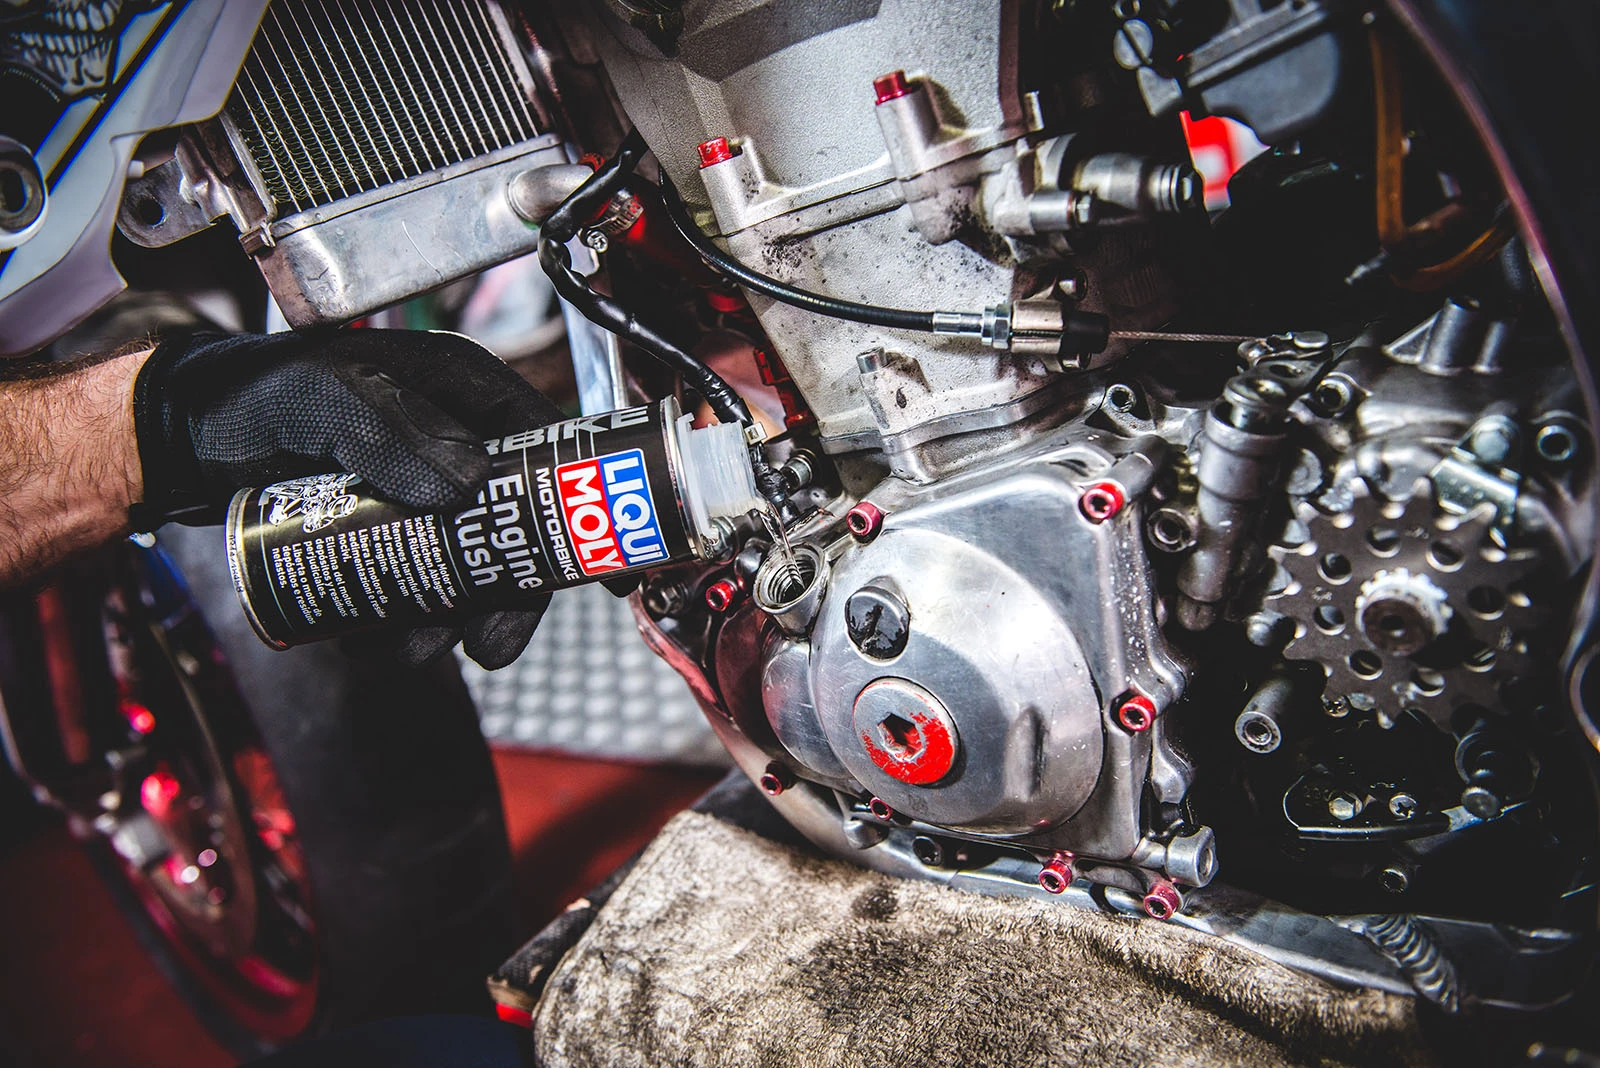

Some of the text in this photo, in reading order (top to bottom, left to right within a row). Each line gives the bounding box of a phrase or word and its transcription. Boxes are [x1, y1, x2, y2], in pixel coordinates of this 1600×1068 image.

[413, 516, 433, 568] schädlichen
[454, 490, 504, 586] lush
[488, 474, 543, 590] Engine
[535, 467, 580, 581] MOTORBIKE
[561, 465, 624, 569] MOLY
[603, 457, 663, 563] LIQUI
[271, 547, 287, 588] nefastos.
[291, 542, 306, 576] Liberta
[301, 583, 318, 608] motor
[312, 608, 322, 616] de
[303, 540, 326, 598] perjudiciales.
[314, 537, 331, 581] depósitos
[328, 587, 347, 617] residuos
[324, 535, 339, 570] Elimina
[333, 570, 345, 585] del
[337, 532, 352, 562] nocivi.
[346, 530, 374, 594] sedimentazioni
[357, 528, 388, 603] Libera il motore da
[370, 525, 388, 574] the engine.
[379, 523, 409, 596] and residues from
[390, 520, 406, 562] Removes
[400, 562, 420, 593] harmful
[403, 518, 431, 590] und Rückständen.
[424, 514, 457, 597] Befreit den Motor von
[281, 544, 298, 588] depósitos
[295, 595, 316, 624] residuos
[338, 585, 353, 607] motor
